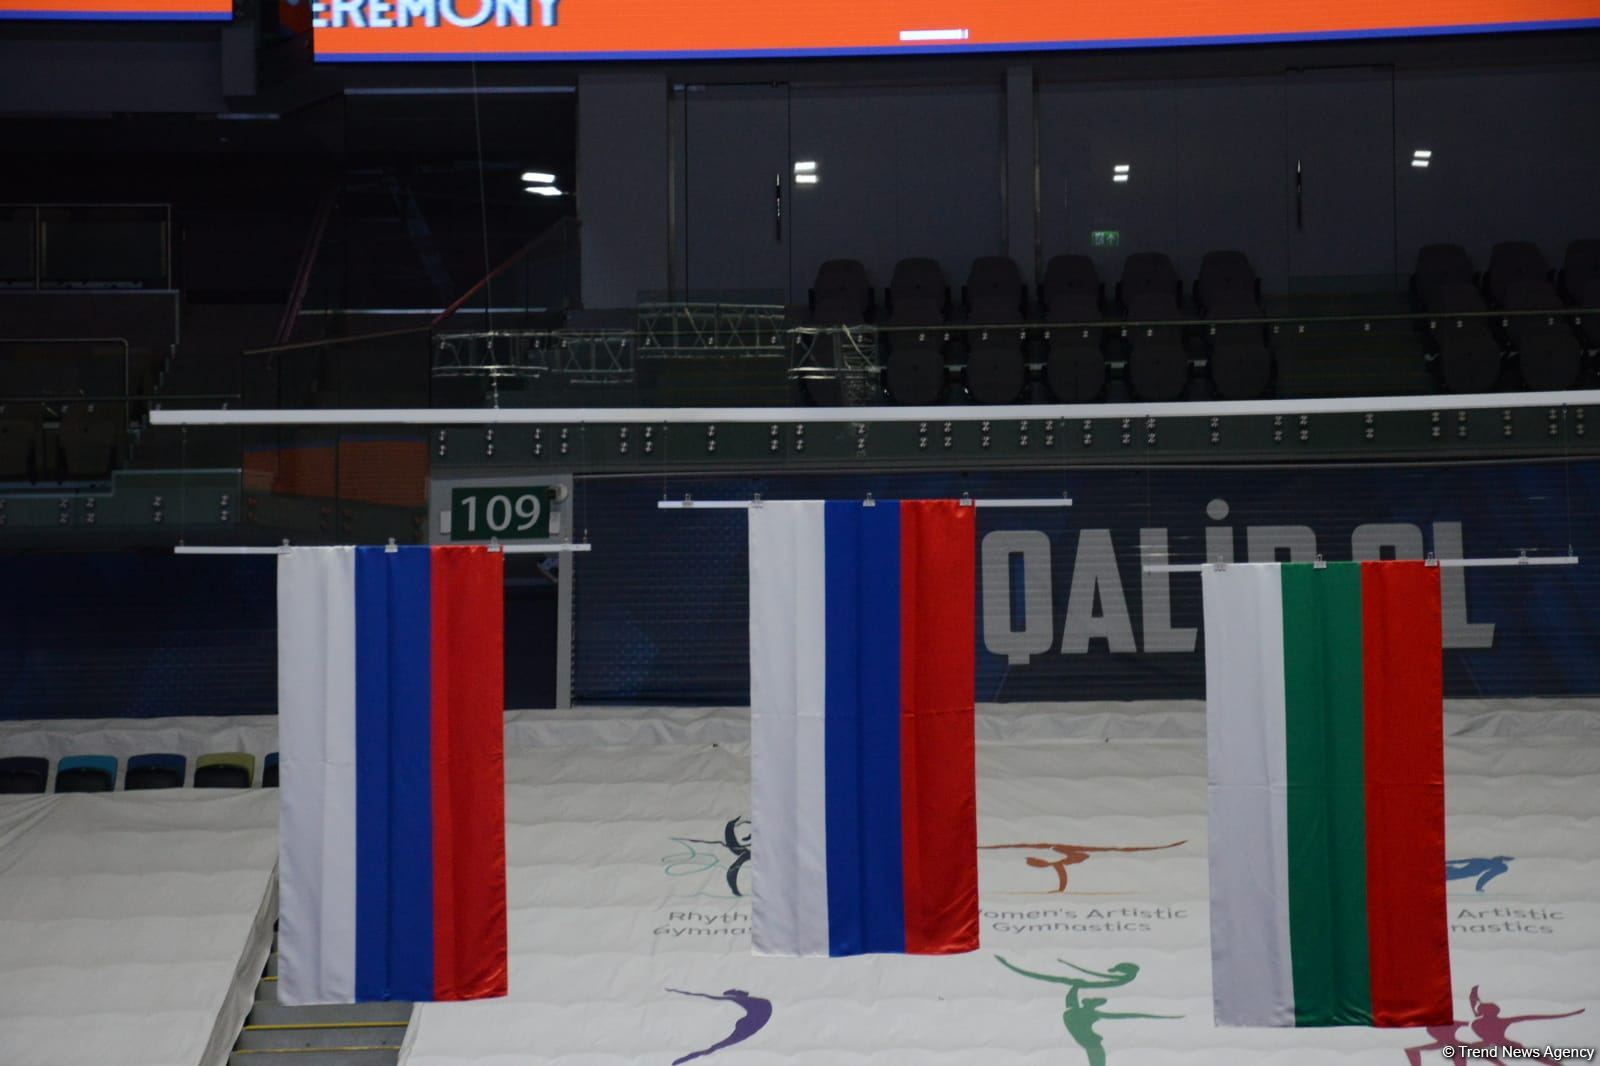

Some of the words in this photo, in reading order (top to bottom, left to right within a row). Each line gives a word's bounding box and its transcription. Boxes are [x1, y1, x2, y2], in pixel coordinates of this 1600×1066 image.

[461, 494, 541, 532] 109
[979, 906, 1077, 919] omen's
[1086, 907, 1189, 919] Artistic
[1457, 908, 1565, 920] Artistic
[992, 921, 1152, 934] Gymnastics
